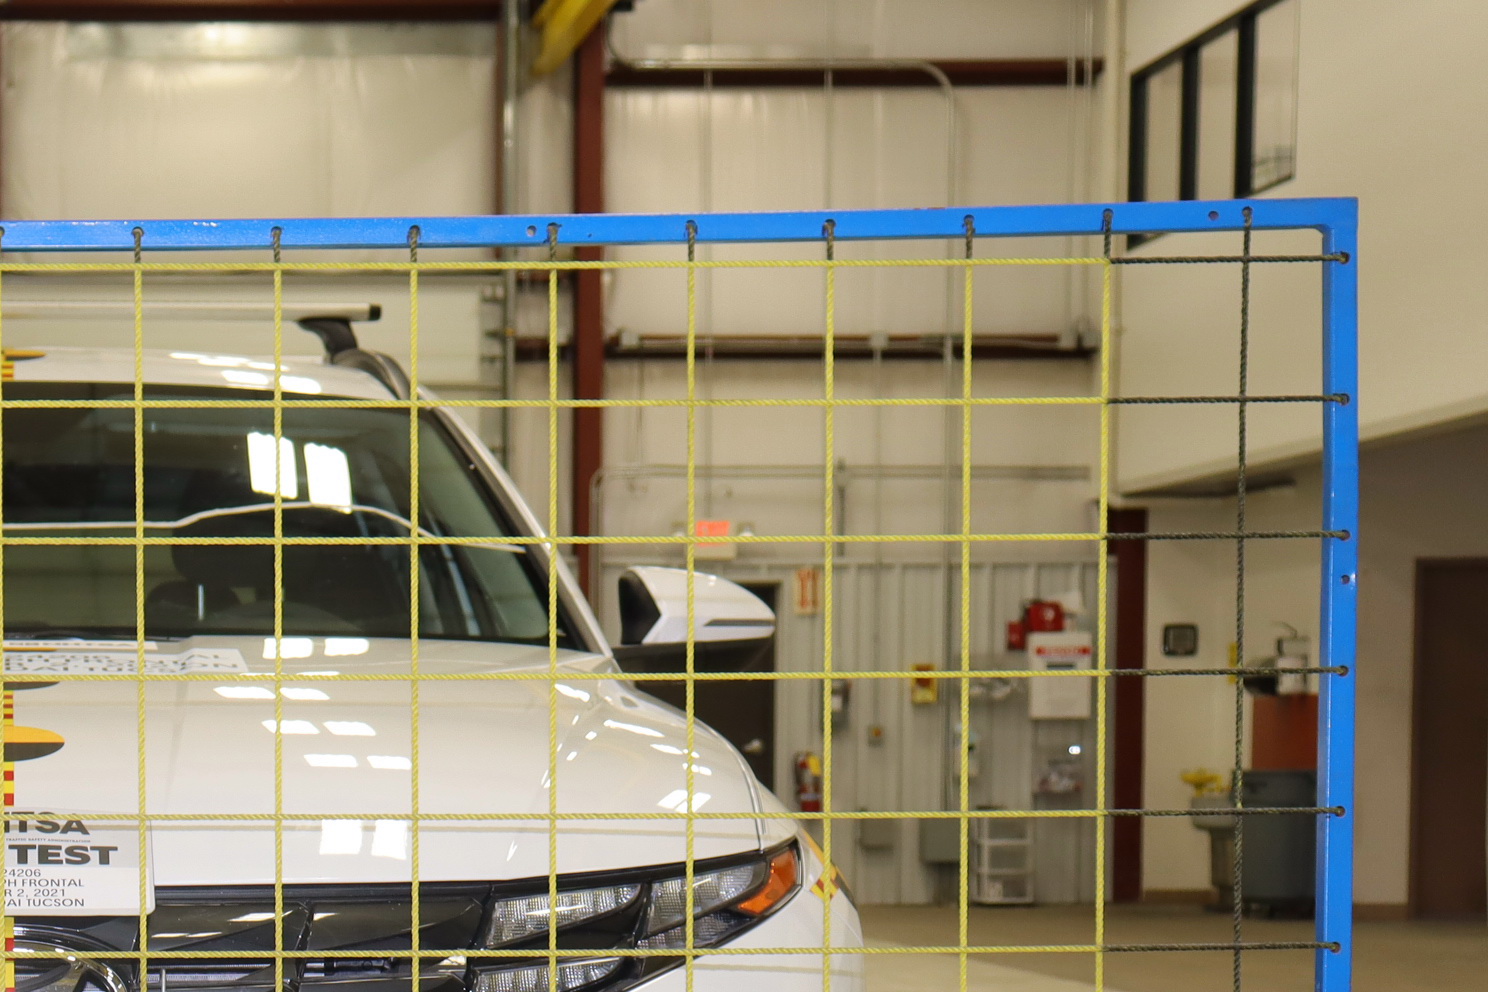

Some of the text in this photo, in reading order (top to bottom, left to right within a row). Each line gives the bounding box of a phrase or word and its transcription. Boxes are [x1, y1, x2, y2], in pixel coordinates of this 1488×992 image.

[8, 844, 118, 866] TEST
[21, 878, 85, 888] FRONTAL
[17, 888, 29, 899] 2,
[34, 888, 65, 898] 2021
[26, 898, 85, 908] TUCSON
